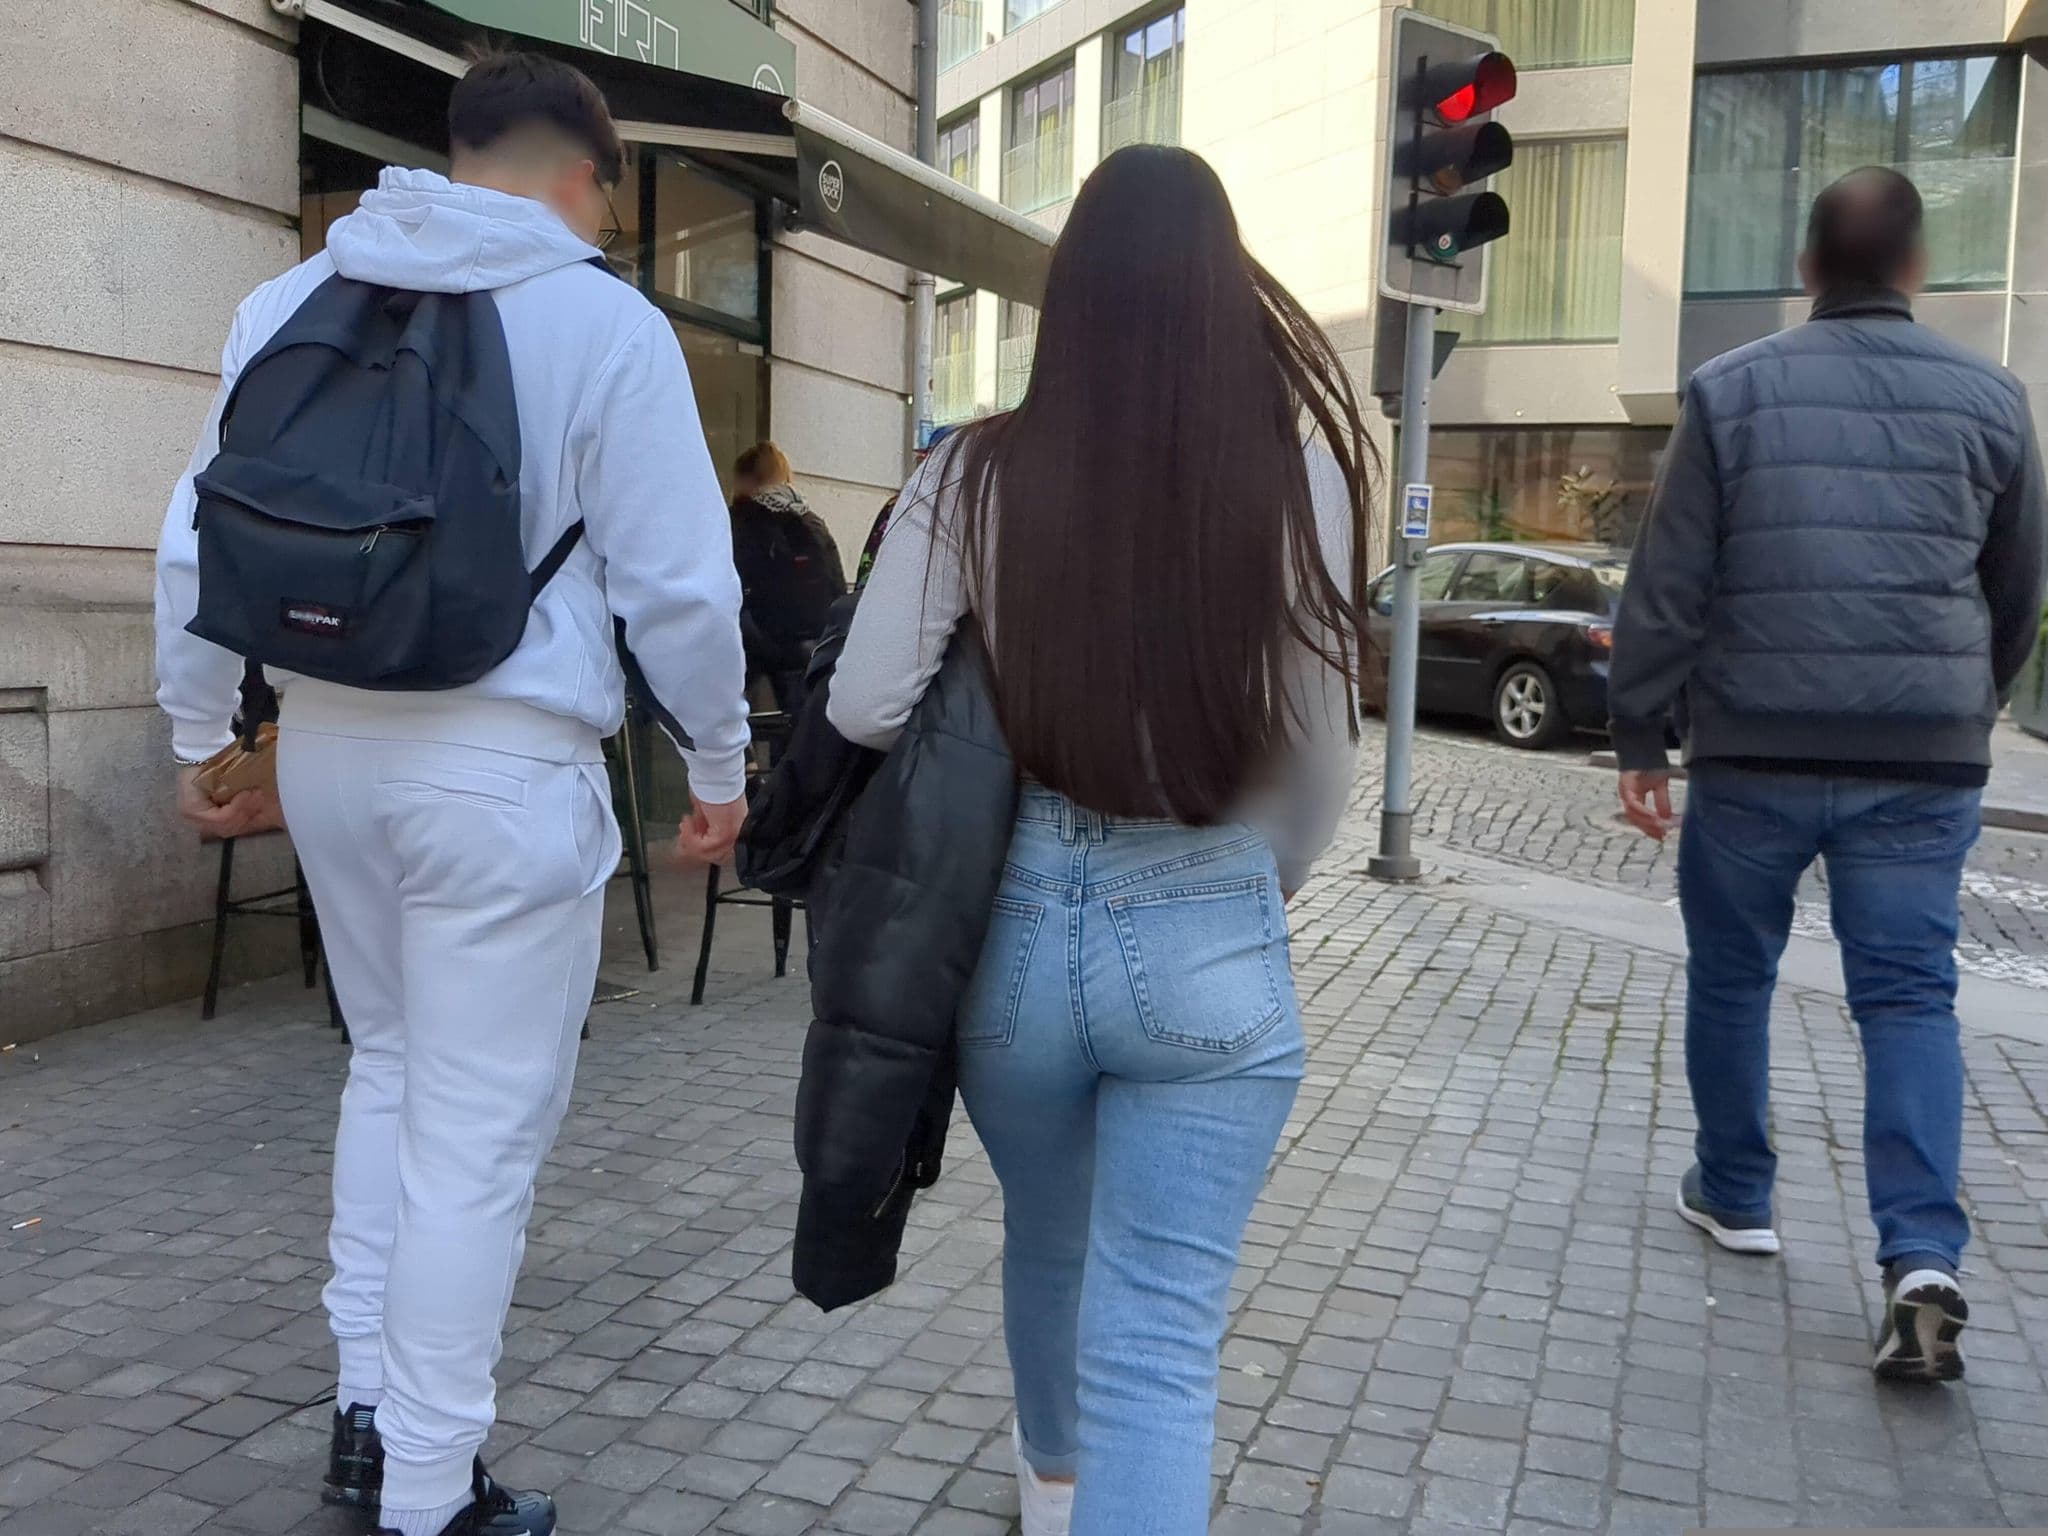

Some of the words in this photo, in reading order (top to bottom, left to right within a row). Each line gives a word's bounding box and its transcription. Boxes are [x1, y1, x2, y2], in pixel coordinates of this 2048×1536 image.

[823, 173, 840, 190] SUPER
[823, 184, 839, 200] BOCK
[288, 609, 340, 626] EPAK
